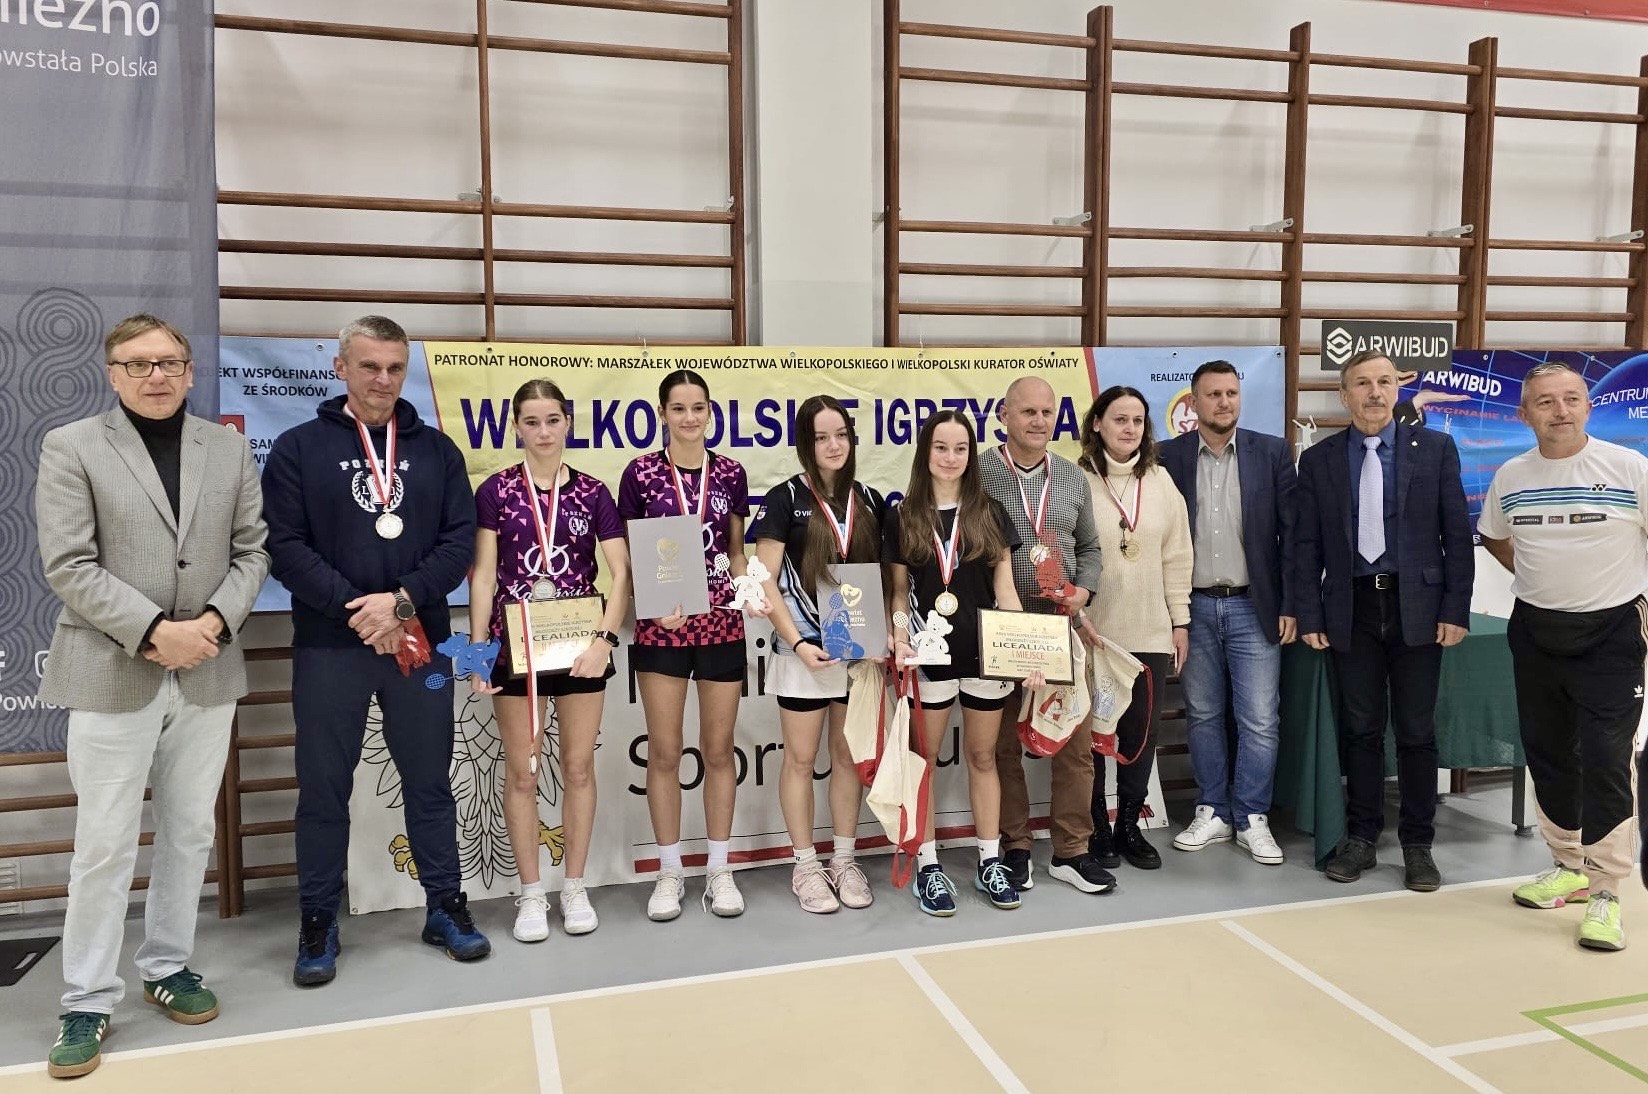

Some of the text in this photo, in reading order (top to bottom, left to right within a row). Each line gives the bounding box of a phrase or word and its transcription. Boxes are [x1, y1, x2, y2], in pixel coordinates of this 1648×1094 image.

[91, 53, 157, 77] Polska
[1353, 335, 1449, 358] ARWIBUD
[434, 354, 1079, 370] PATRONAT HONOROWY: MARSZAŁEK WOJEWÓDZTWA WIELKOPOLSKIEGO I WIELKOPOLSKI KURATOR OŚWIATY
[242, 366, 340, 380] WSPÓŁFINANS
[243, 383, 328, 397] ZE ŚRODKÓW
[1422, 370, 1502, 397] ARWIBUD
[992, 641, 1064, 653] LICEALIADA
